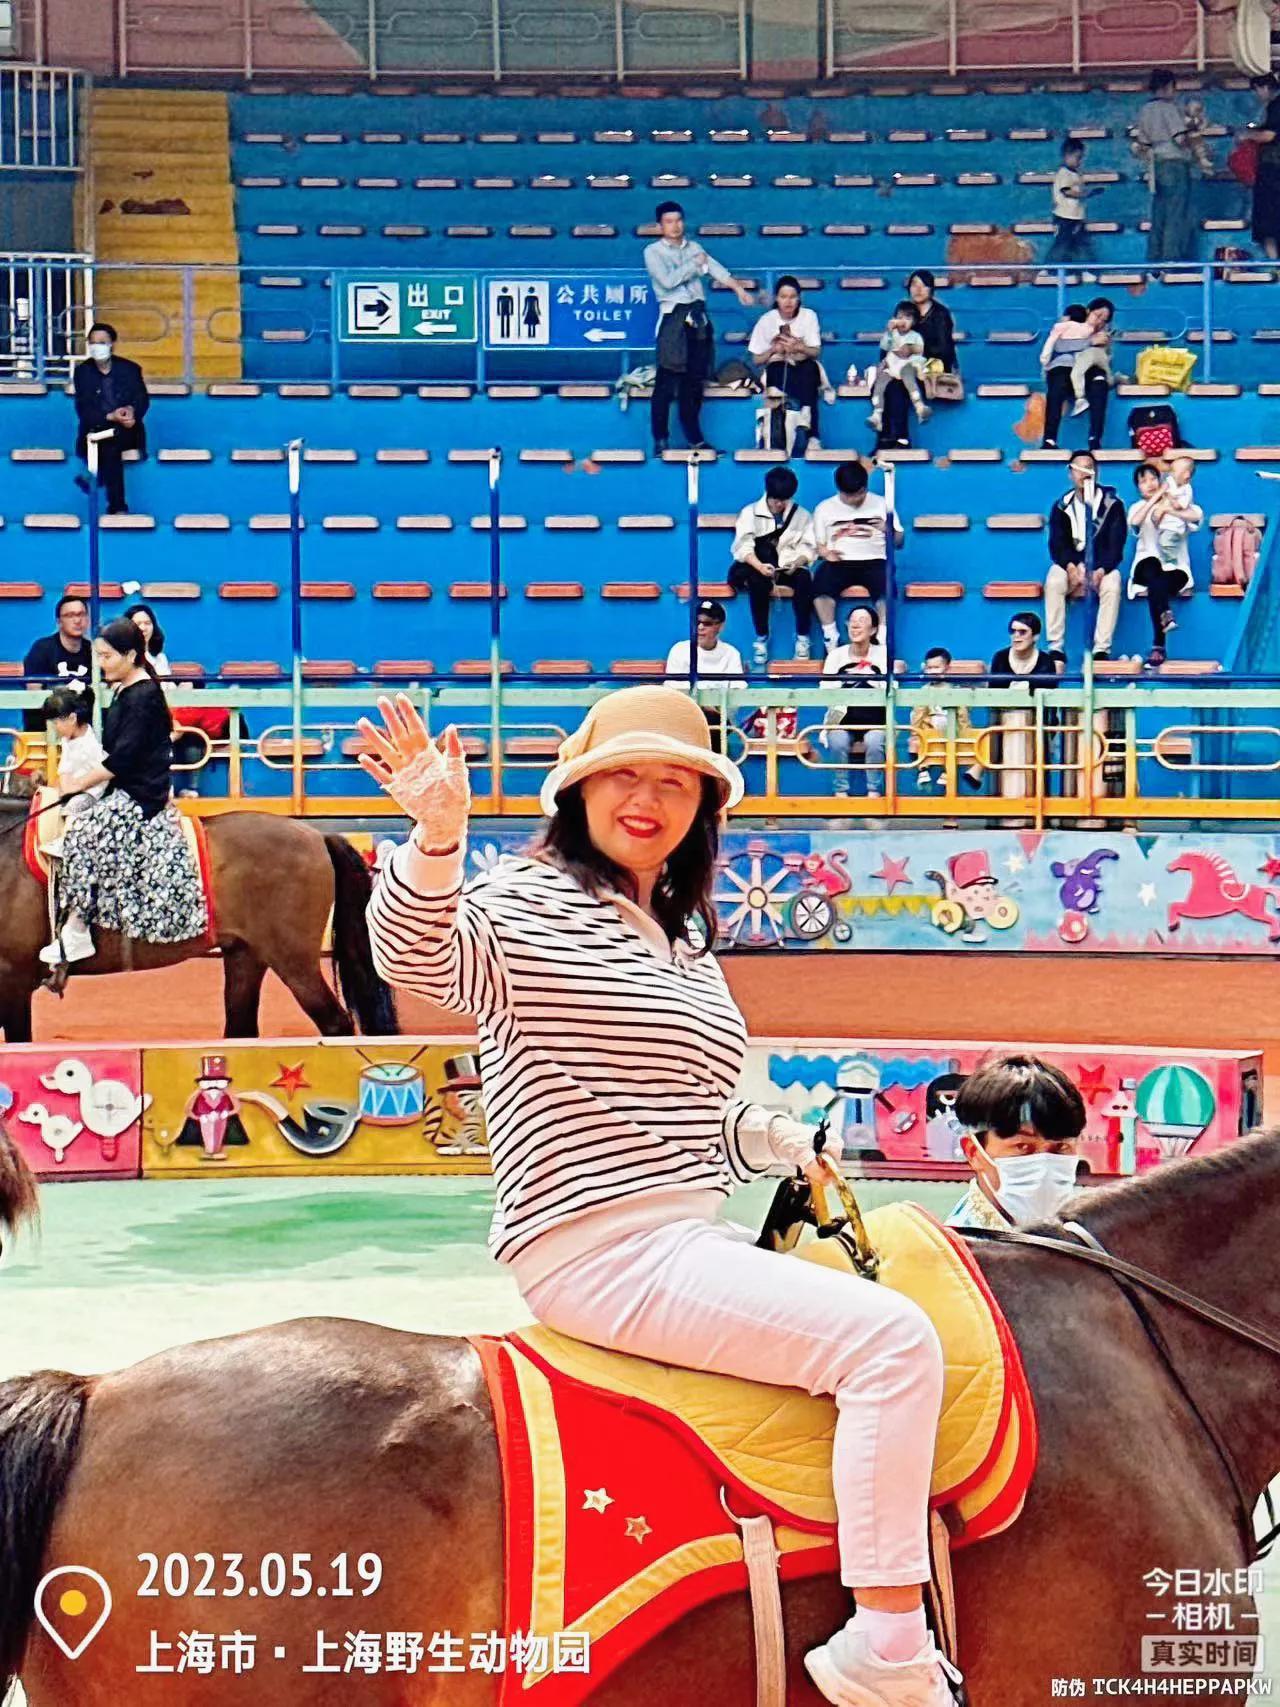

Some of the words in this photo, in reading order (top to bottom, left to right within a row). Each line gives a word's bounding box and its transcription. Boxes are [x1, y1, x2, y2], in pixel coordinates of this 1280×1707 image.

[407, 282, 464, 307] 出口
[556, 284, 649, 305] 公共厕所
[421, 309, 451, 320] EXIT
[573, 309, 633, 321] TOILET
